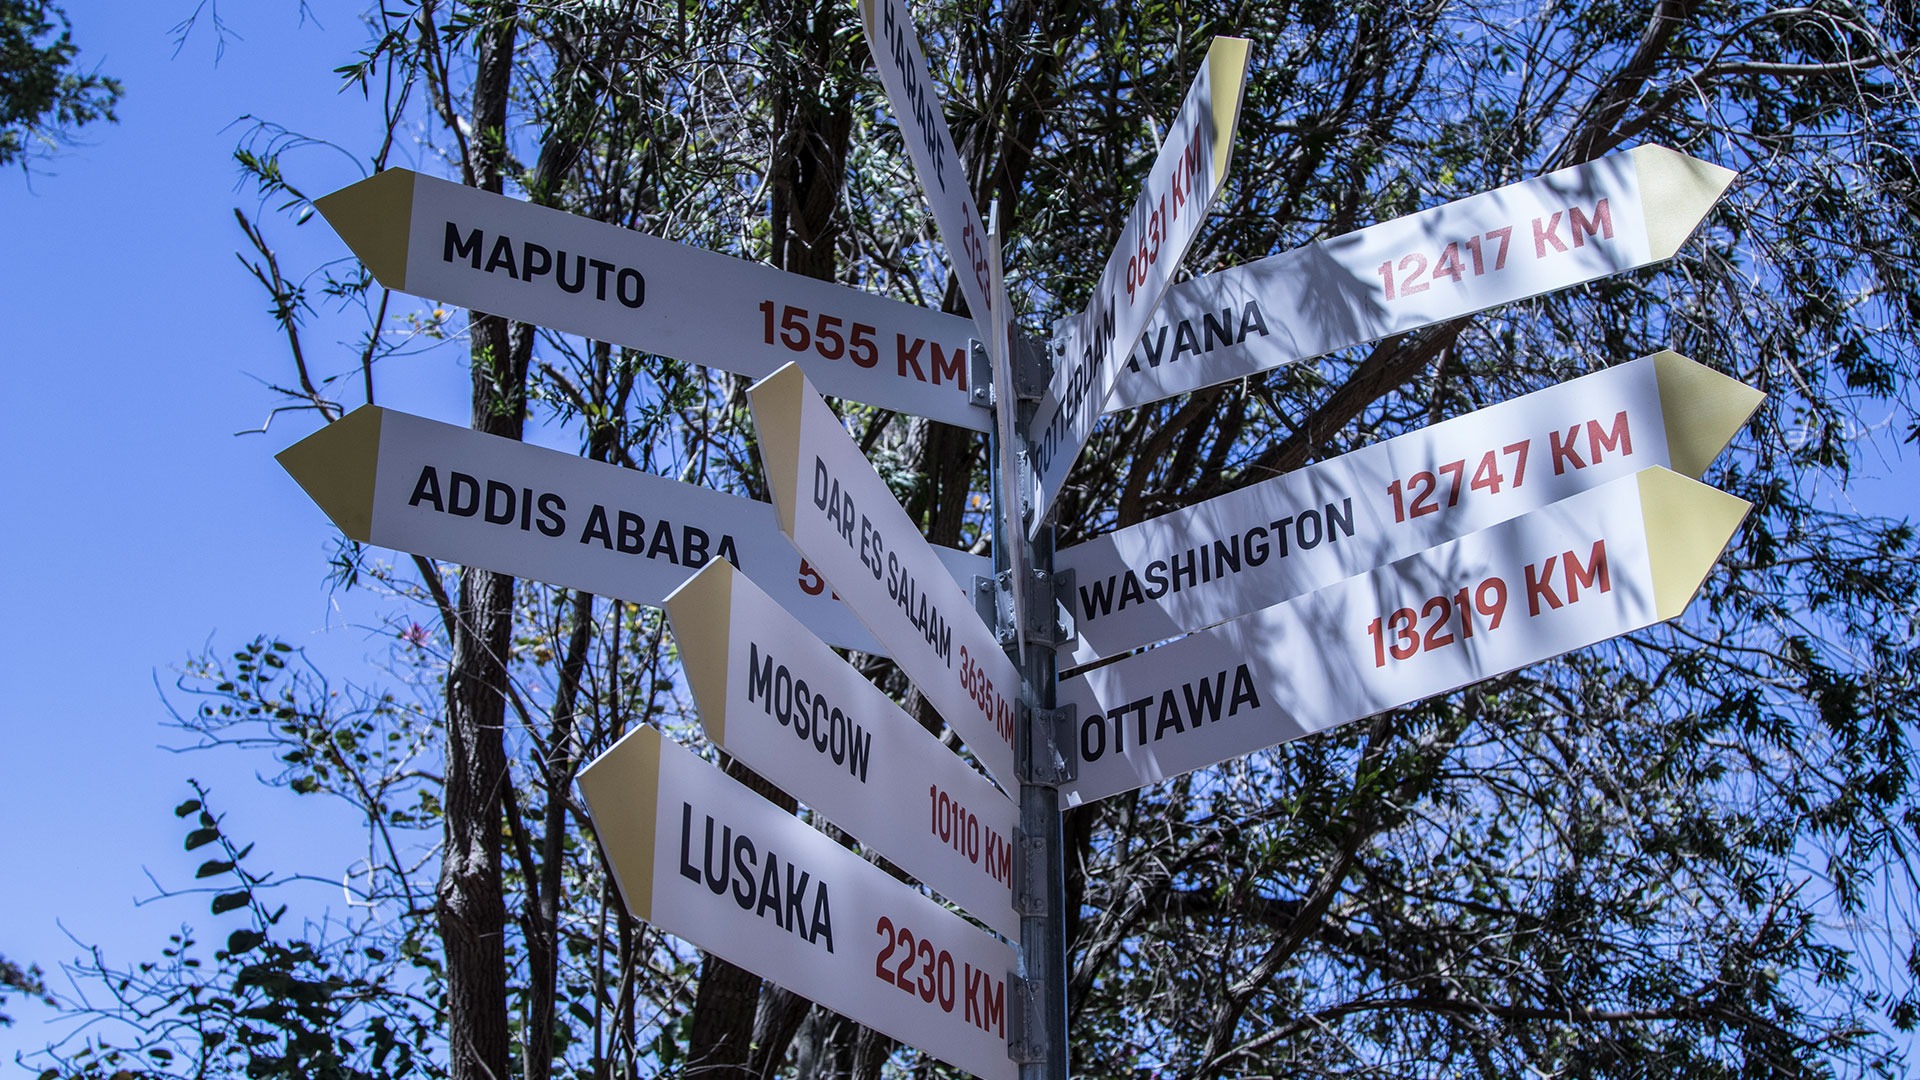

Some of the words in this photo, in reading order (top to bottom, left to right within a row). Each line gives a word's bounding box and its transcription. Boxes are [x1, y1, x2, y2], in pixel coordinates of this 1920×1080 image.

[884, 0, 945, 194] HARARE
[443, 221, 645, 309] MAPUTO
[759, 300, 879, 369] 1555
[896, 333, 968, 392] KM
[1035, 295, 1116, 491] ROTTERDAM
[1127, 193, 1166, 306] 9631
[1171, 122, 1201, 222] KM
[1127, 300, 1270, 374] VANA
[1378, 226, 1513, 301] 12417
[1532, 198, 1614, 259] KM
[408, 465, 567, 538] ADDIS
[580, 504, 742, 572] ABABA
[813, 455, 855, 549] DAR
[860, 513, 884, 581] ES
[887, 551, 952, 670] SALAAM
[959, 645, 994, 722] 3635
[993, 691, 1015, 751] KM
[1079, 497, 1356, 622] WASHINGTON
[1387, 439, 1531, 523] 12747
[1549, 411, 1633, 476] KM
[1080, 664, 1261, 763] OTTAWA
[1368, 577, 1508, 668] 13219
[1524, 539, 1611, 618] KM
[748, 641, 872, 784] MOSCOW
[930, 785, 980, 865] 10110
[985, 825, 1012, 890] KM
[680, 801, 835, 954] LUSAKA
[876, 916, 956, 1013] 2230
[964, 962, 1005, 1040] KM
